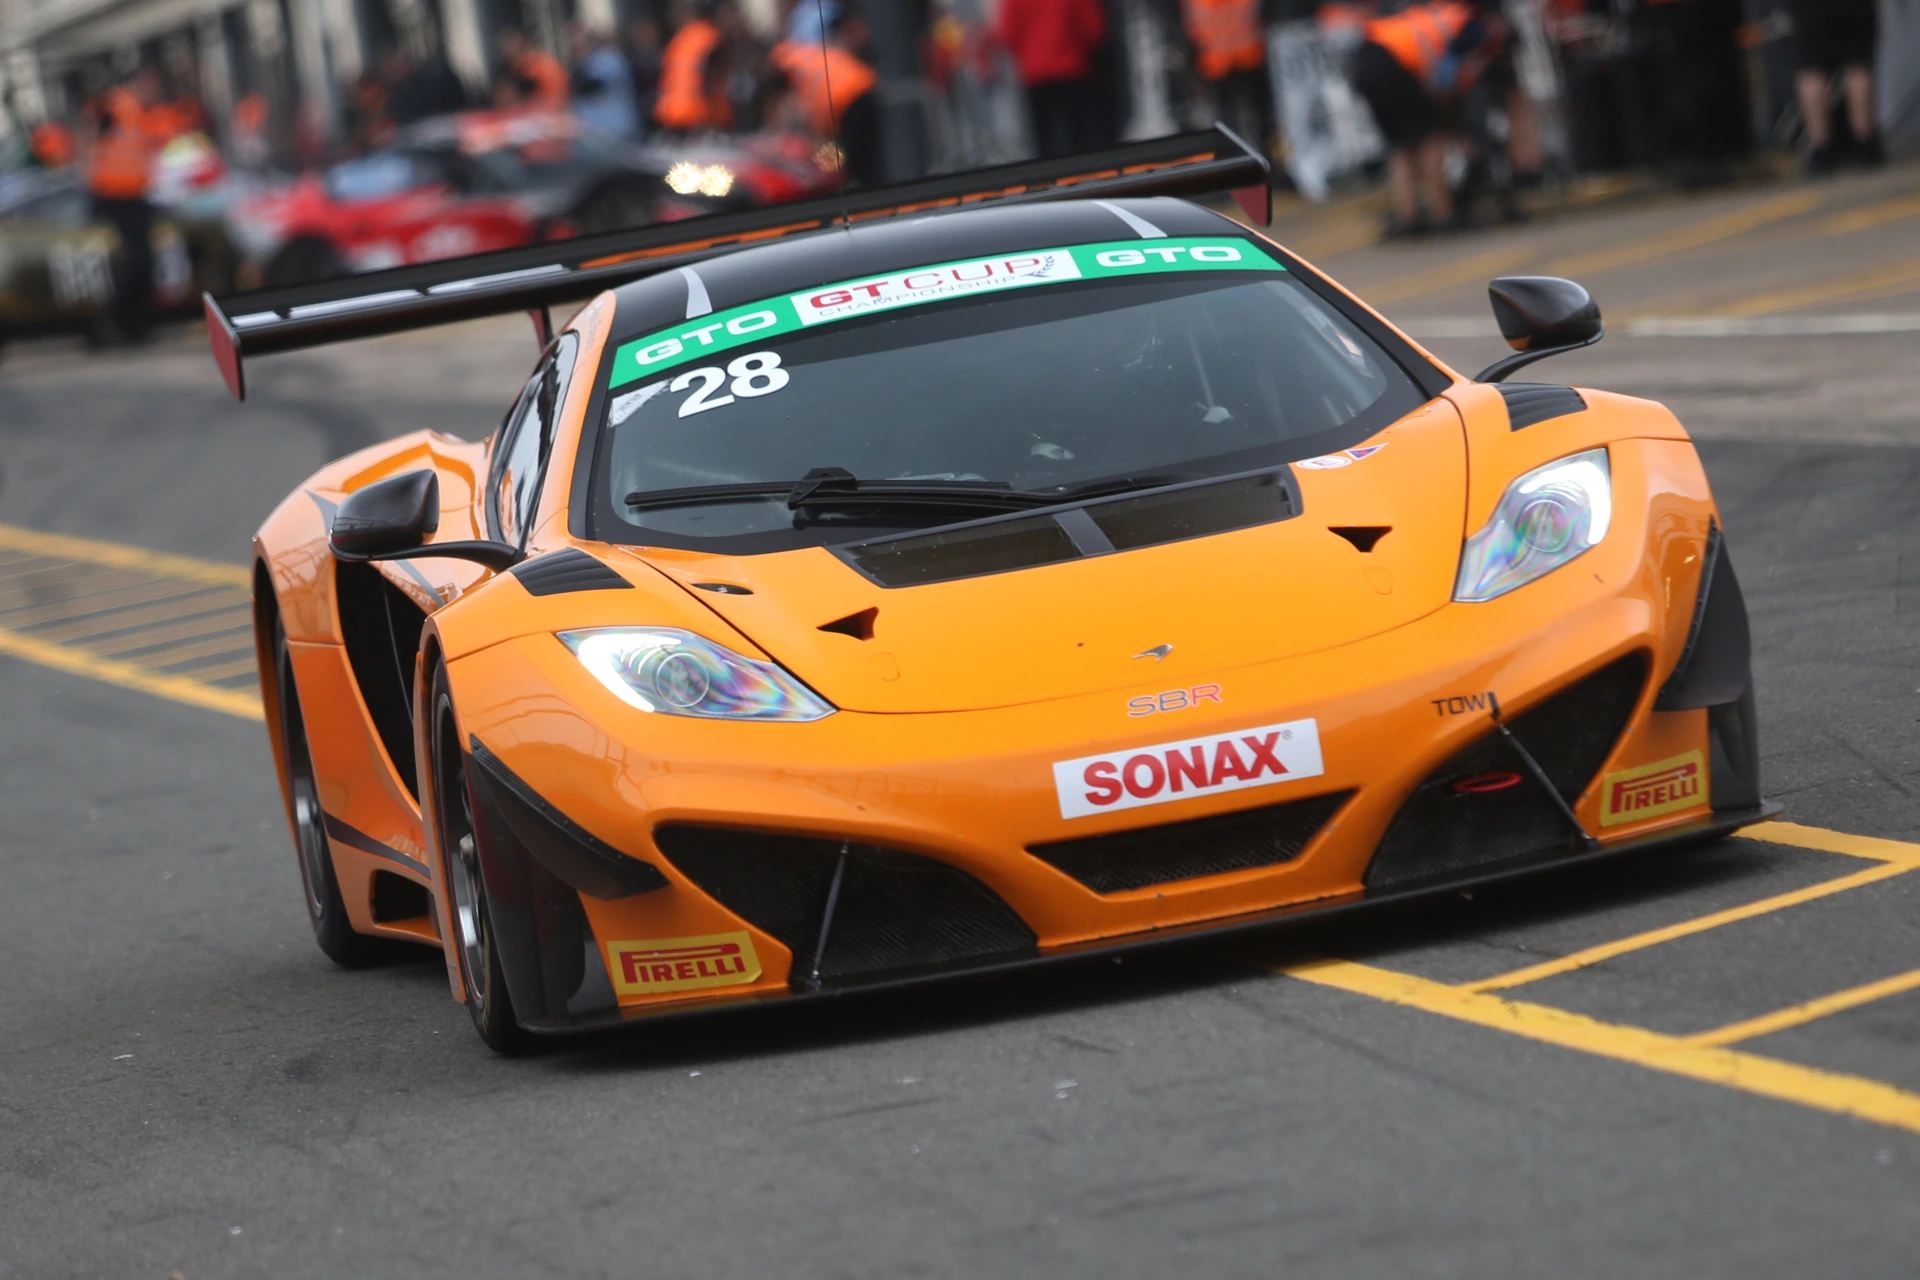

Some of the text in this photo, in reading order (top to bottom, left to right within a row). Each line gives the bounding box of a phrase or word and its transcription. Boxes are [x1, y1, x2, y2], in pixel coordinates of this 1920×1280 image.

[1096, 246, 1242, 267] GTO
[810, 258, 1040, 309] GT CUP
[819, 275, 1016, 317] CHAMPIONSHIP
[635, 310, 777, 365] GTO
[670, 351, 790, 418] 28
[1127, 683, 1223, 718] SBR
[1432, 693, 1486, 717] TOW
[1610, 762, 1699, 815] PIRELLI
[619, 943, 746, 984] PIRELLI
